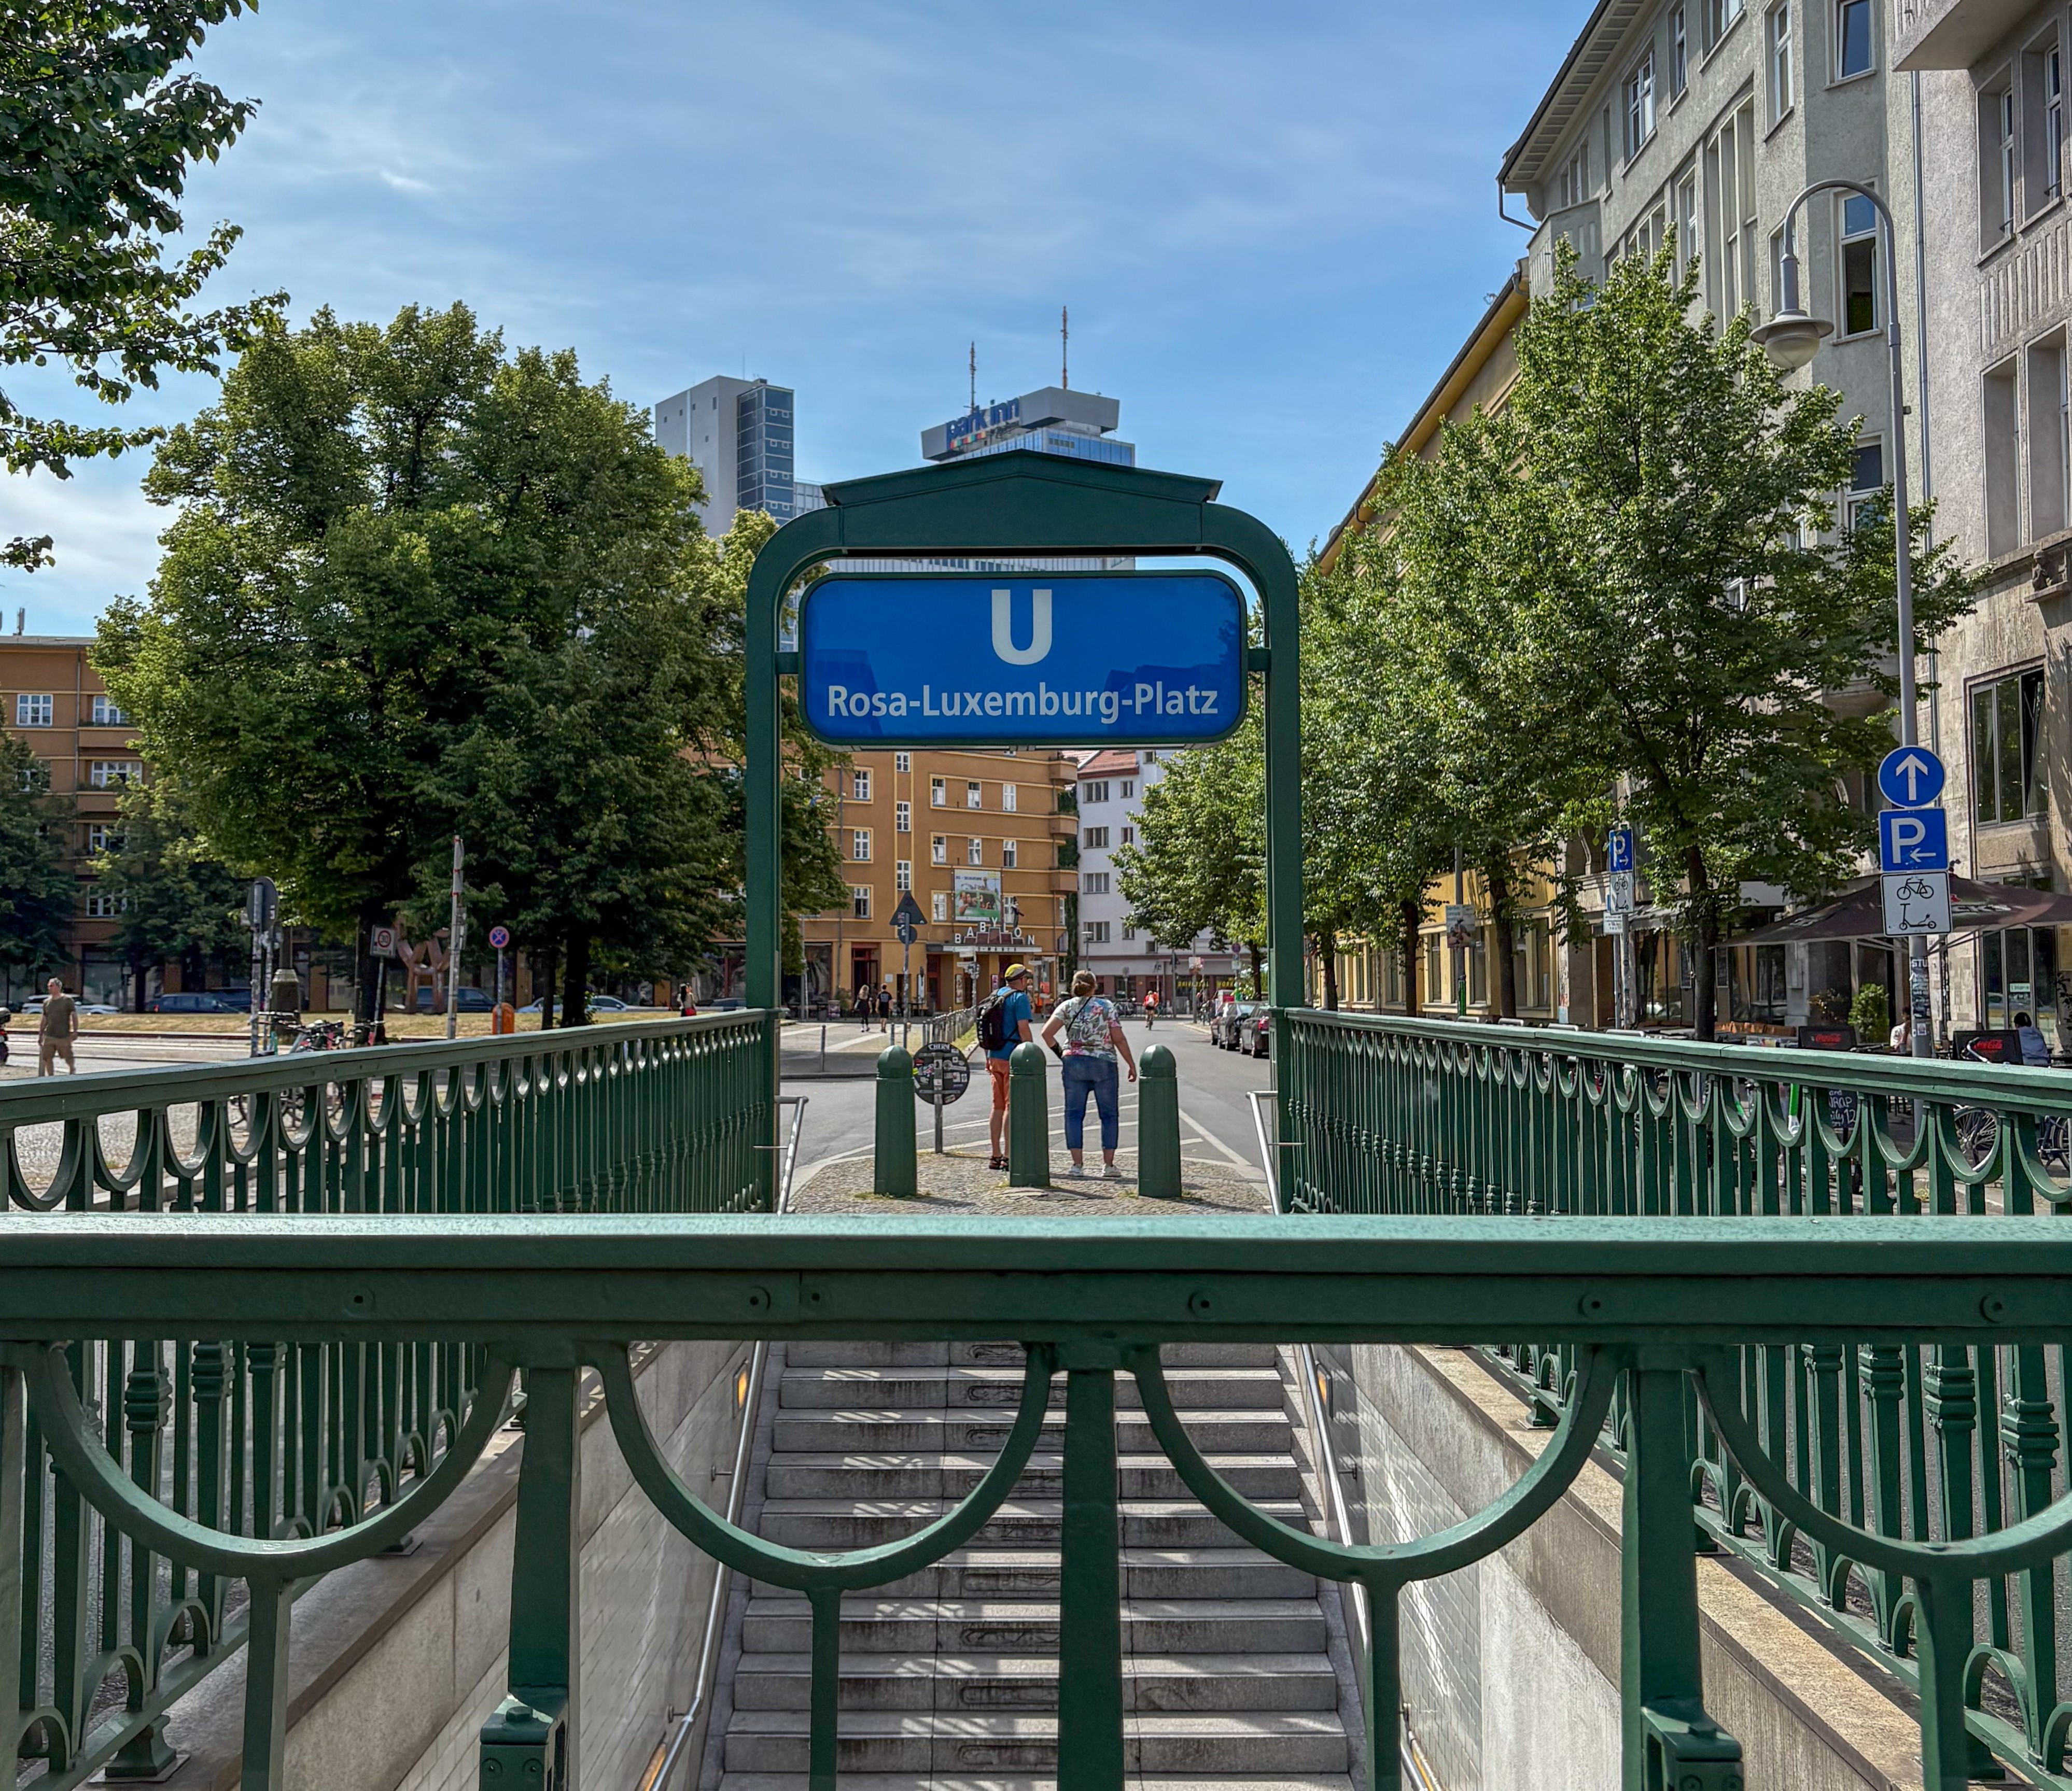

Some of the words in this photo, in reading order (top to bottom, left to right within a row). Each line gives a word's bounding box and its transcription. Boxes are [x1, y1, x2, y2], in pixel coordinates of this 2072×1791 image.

[946, 405, 987, 451] park
[990, 394, 1019, 426] inn
[991, 589, 1052, 665] U
[829, 682, 1218, 724] Rosa-Luxemburg-Platz
[1613, 835, 1626, 867] P
[1891, 817, 1925, 863] P
[955, 917, 1035, 944] BABYLON
